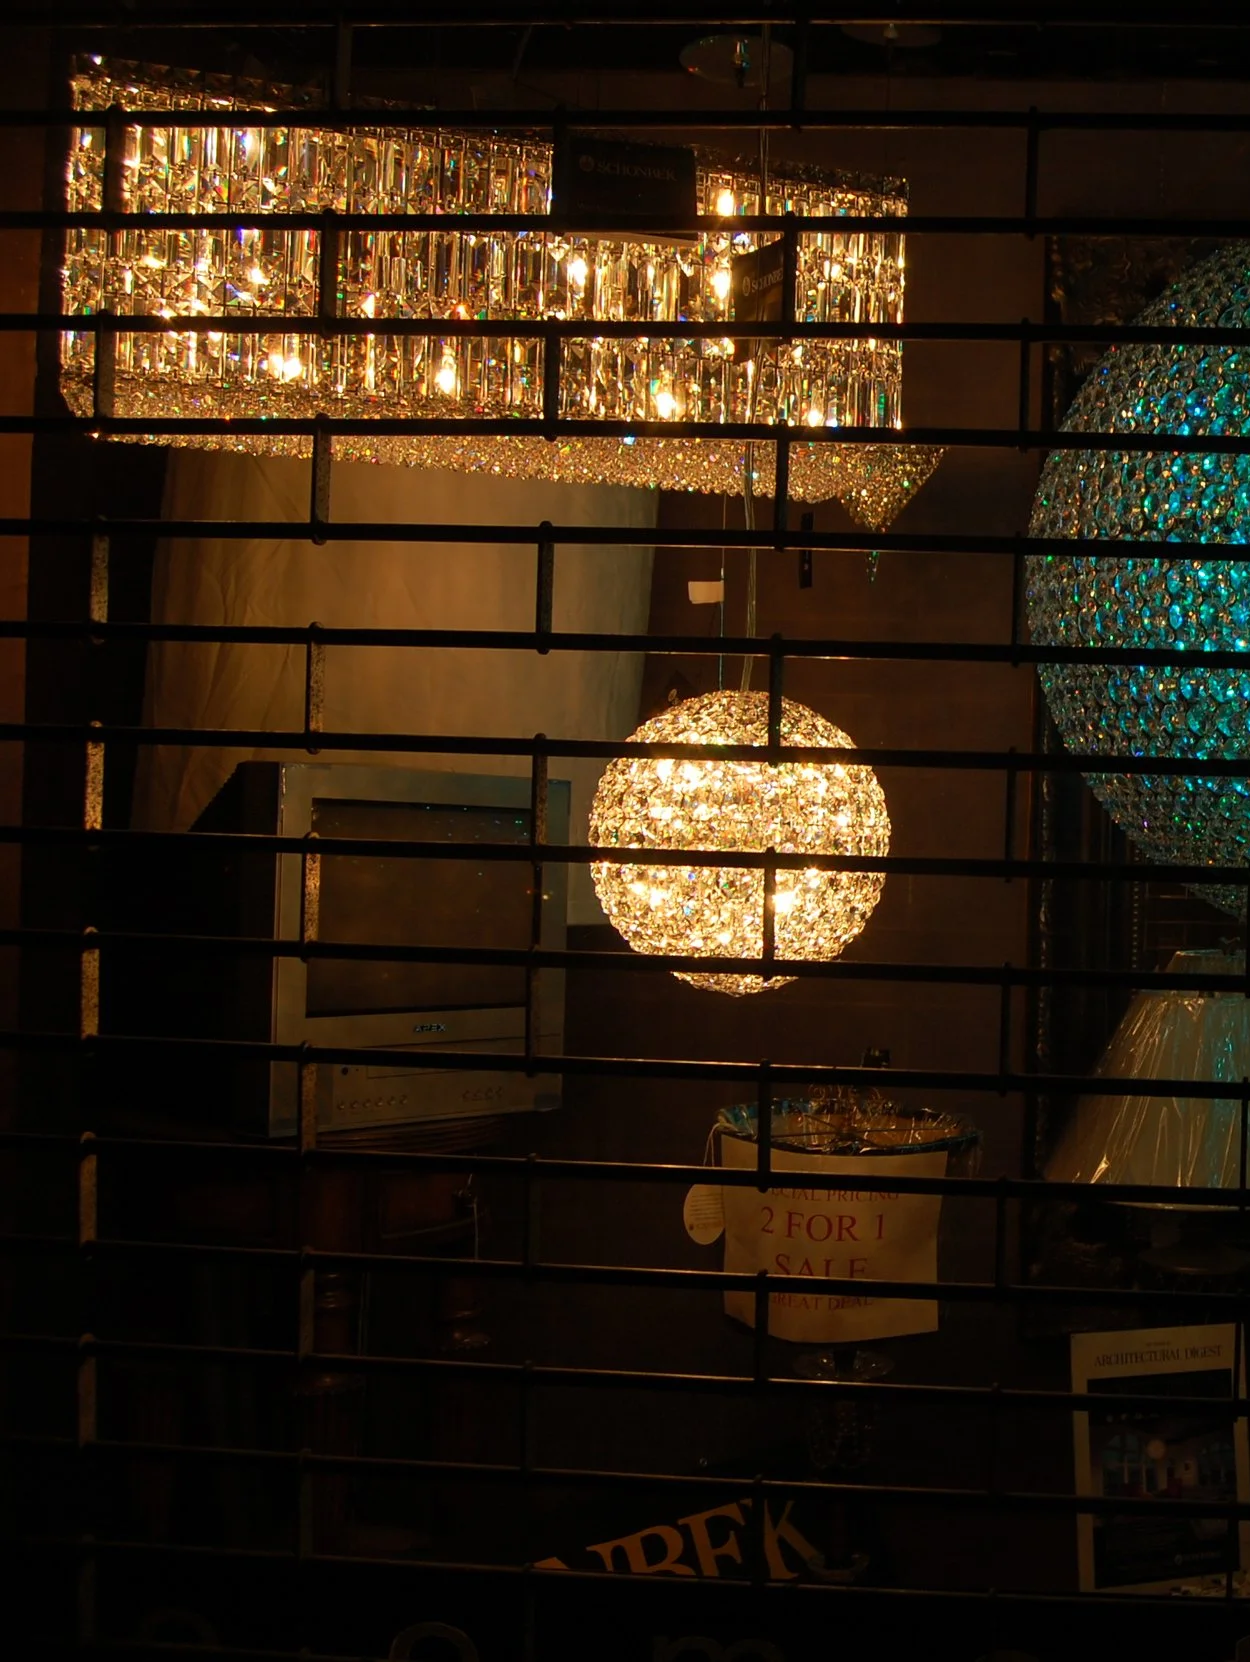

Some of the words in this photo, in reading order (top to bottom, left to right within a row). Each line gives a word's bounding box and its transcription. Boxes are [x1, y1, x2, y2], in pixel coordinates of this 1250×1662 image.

[597, 160, 677, 181] SCHONBEK
[760, 1206, 775, 1234] 2
[785, 1210, 861, 1242] FOR
[774, 1252, 869, 1280] SALE
[1093, 1347, 1181, 1368] ARCHITECTURAL
[1184, 1343, 1223, 1360] DIGEST
